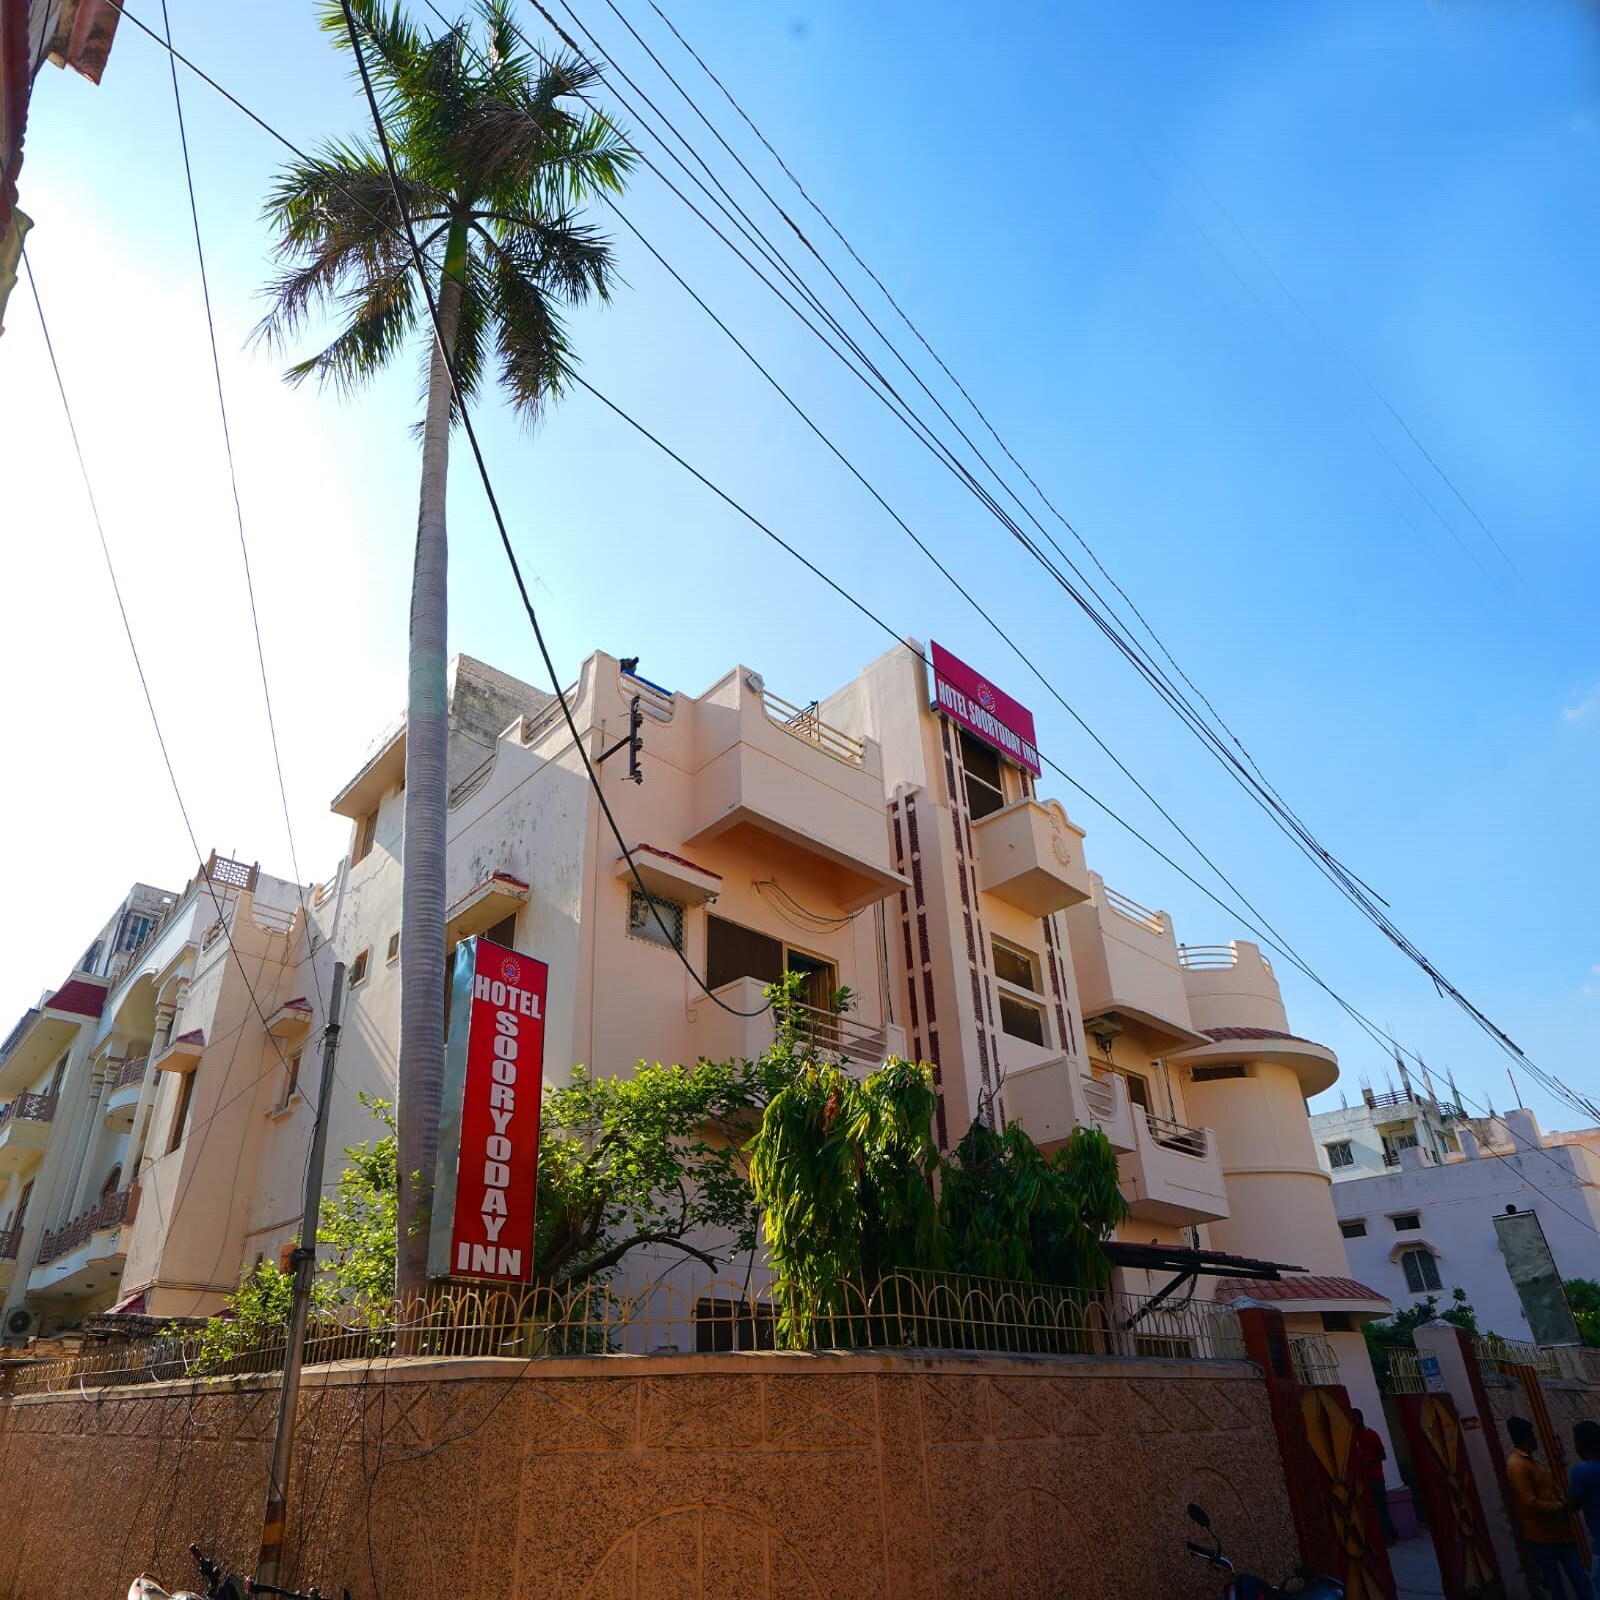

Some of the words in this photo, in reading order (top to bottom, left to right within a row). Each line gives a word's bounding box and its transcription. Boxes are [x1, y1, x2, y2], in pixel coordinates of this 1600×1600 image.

[938, 679, 969, 720] HOTEL
[1021, 737, 1039, 769] INN
[473, 974, 541, 1019] HOTEL
[481, 1010, 519, 1241] SOORYODAY
[457, 1242, 521, 1276] INN
